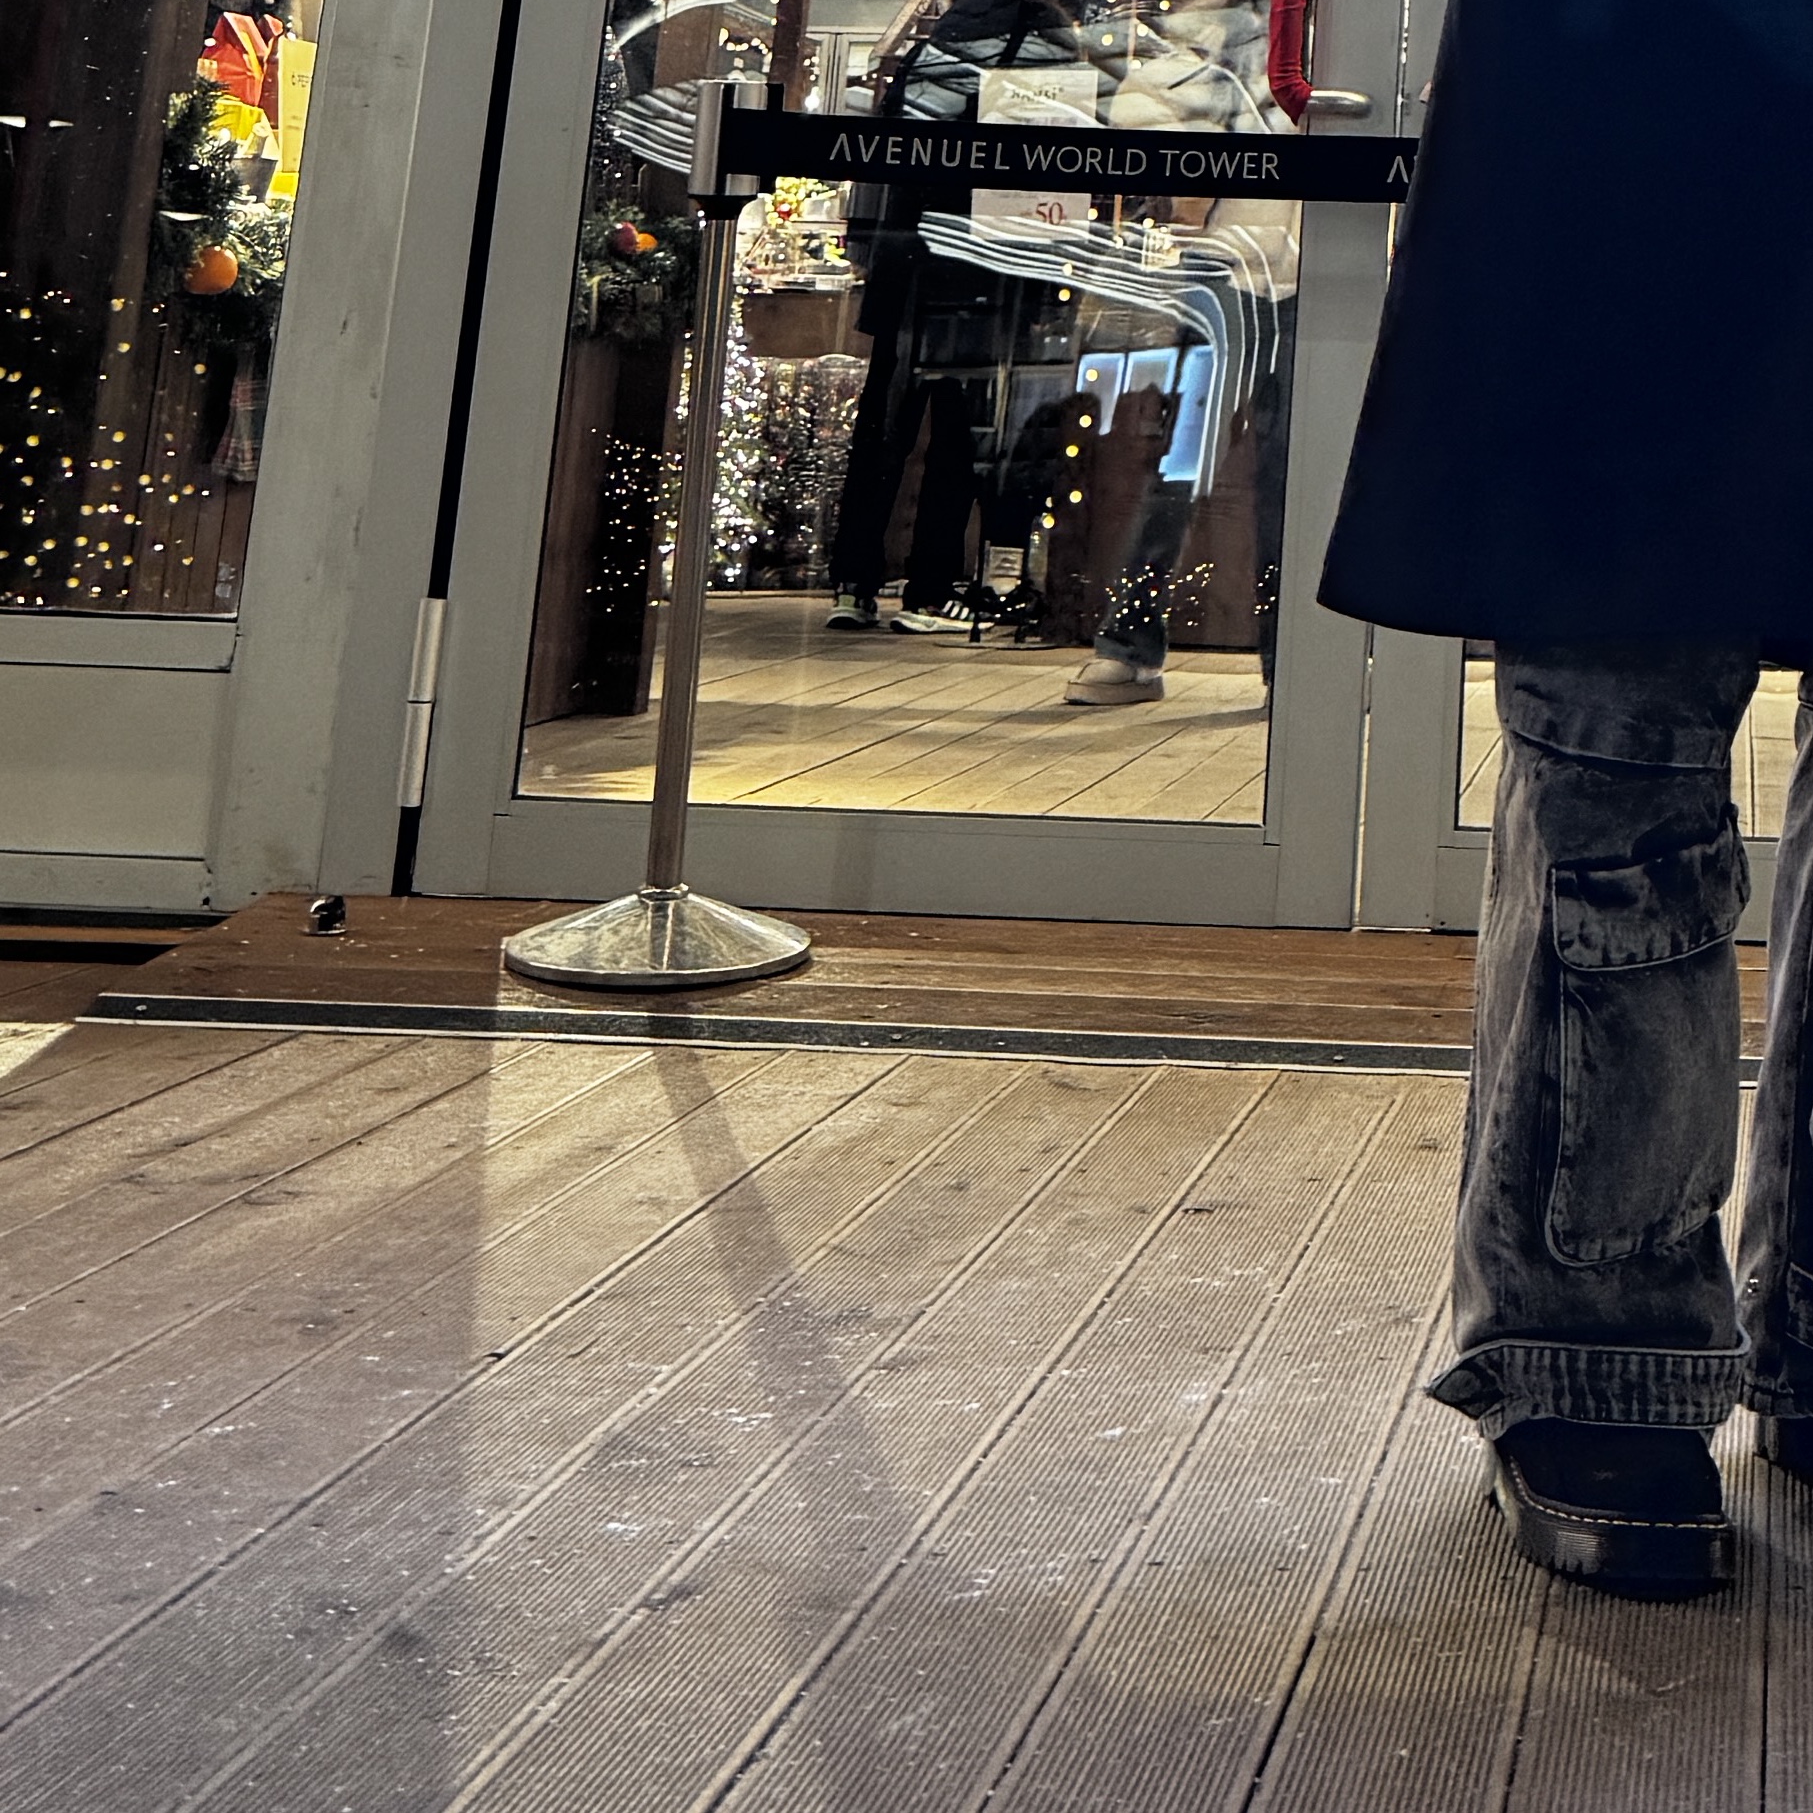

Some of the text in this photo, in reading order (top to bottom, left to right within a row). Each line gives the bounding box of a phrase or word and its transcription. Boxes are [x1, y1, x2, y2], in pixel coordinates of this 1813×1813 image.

[829, 132, 1280, 181] AVENUEL WORLD TOWER
